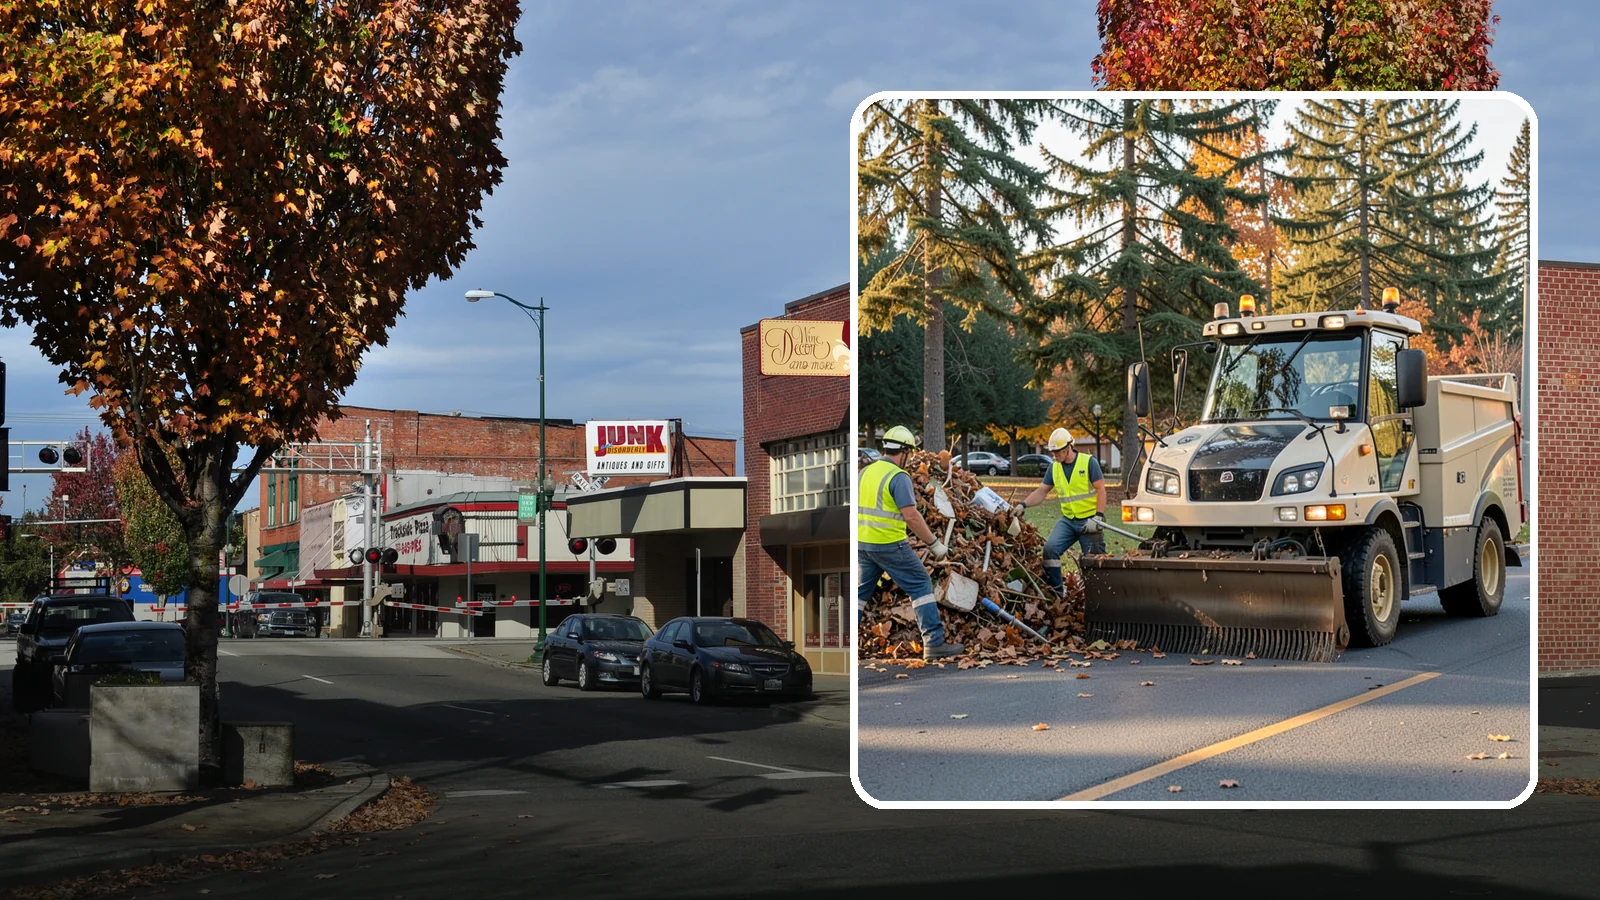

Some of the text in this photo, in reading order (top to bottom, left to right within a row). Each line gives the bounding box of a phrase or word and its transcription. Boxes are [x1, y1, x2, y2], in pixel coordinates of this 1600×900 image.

[765, 327, 831, 365] Decor
[595, 425, 664, 457] JUNK
[607, 446, 646, 454] DISORDERLY
[597, 460, 665, 470] ANTIQUES AND GIFTS
[590, 476, 607, 491] SING
[414, 519, 429, 534] Pizza
